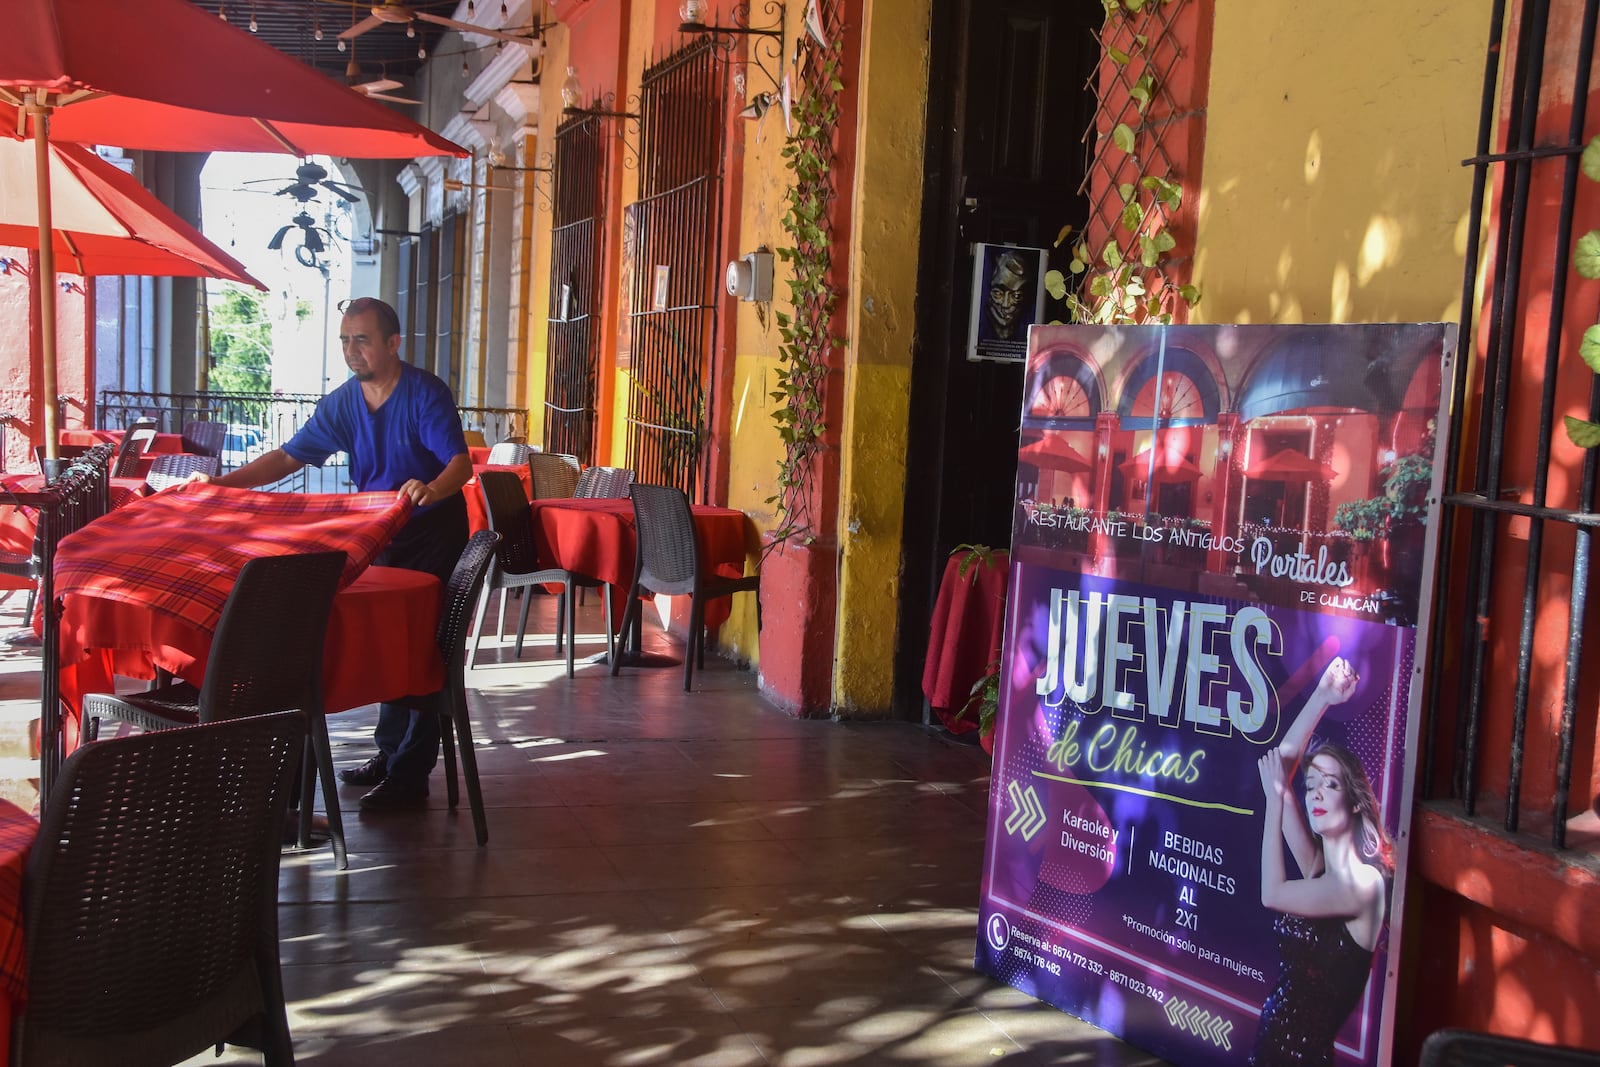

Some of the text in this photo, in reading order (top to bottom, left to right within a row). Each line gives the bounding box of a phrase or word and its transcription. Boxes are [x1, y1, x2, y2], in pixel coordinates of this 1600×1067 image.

[1030, 510, 1245, 554] RESTAURANTE LOS ANTIGUOS
[1251, 536, 1354, 587] Portales
[1300, 590, 1379, 613] DE CULIACÁN
[1036, 588, 1282, 744] JUEVES
[1046, 720, 1207, 783] de Chicas
[1062, 809, 1119, 844] Karaoke y
[1061, 831, 1115, 865] Diversión
[1164, 831, 1224, 866] BEBIDAS
[1149, 850, 1236, 895] NACIONALES
[1179, 886, 1198, 907] AL
[1175, 908, 1198, 931] 2X1
[1011, 925, 1041, 948] Reserva
[1042, 939, 1051, 952] al:
[1052, 944, 1072, 962] 6674
[1073, 952, 1087, 969] 772
[1088, 960, 1103, 976] 332
[1129, 979, 1145, 995] 023
[1146, 986, 1164, 1003] 242
[1045, 961, 1061, 977] 482
[1176, 937, 1196, 954] solo
[1198, 947, 1220, 964] para
[1222, 955, 1266, 983] mujeres.
